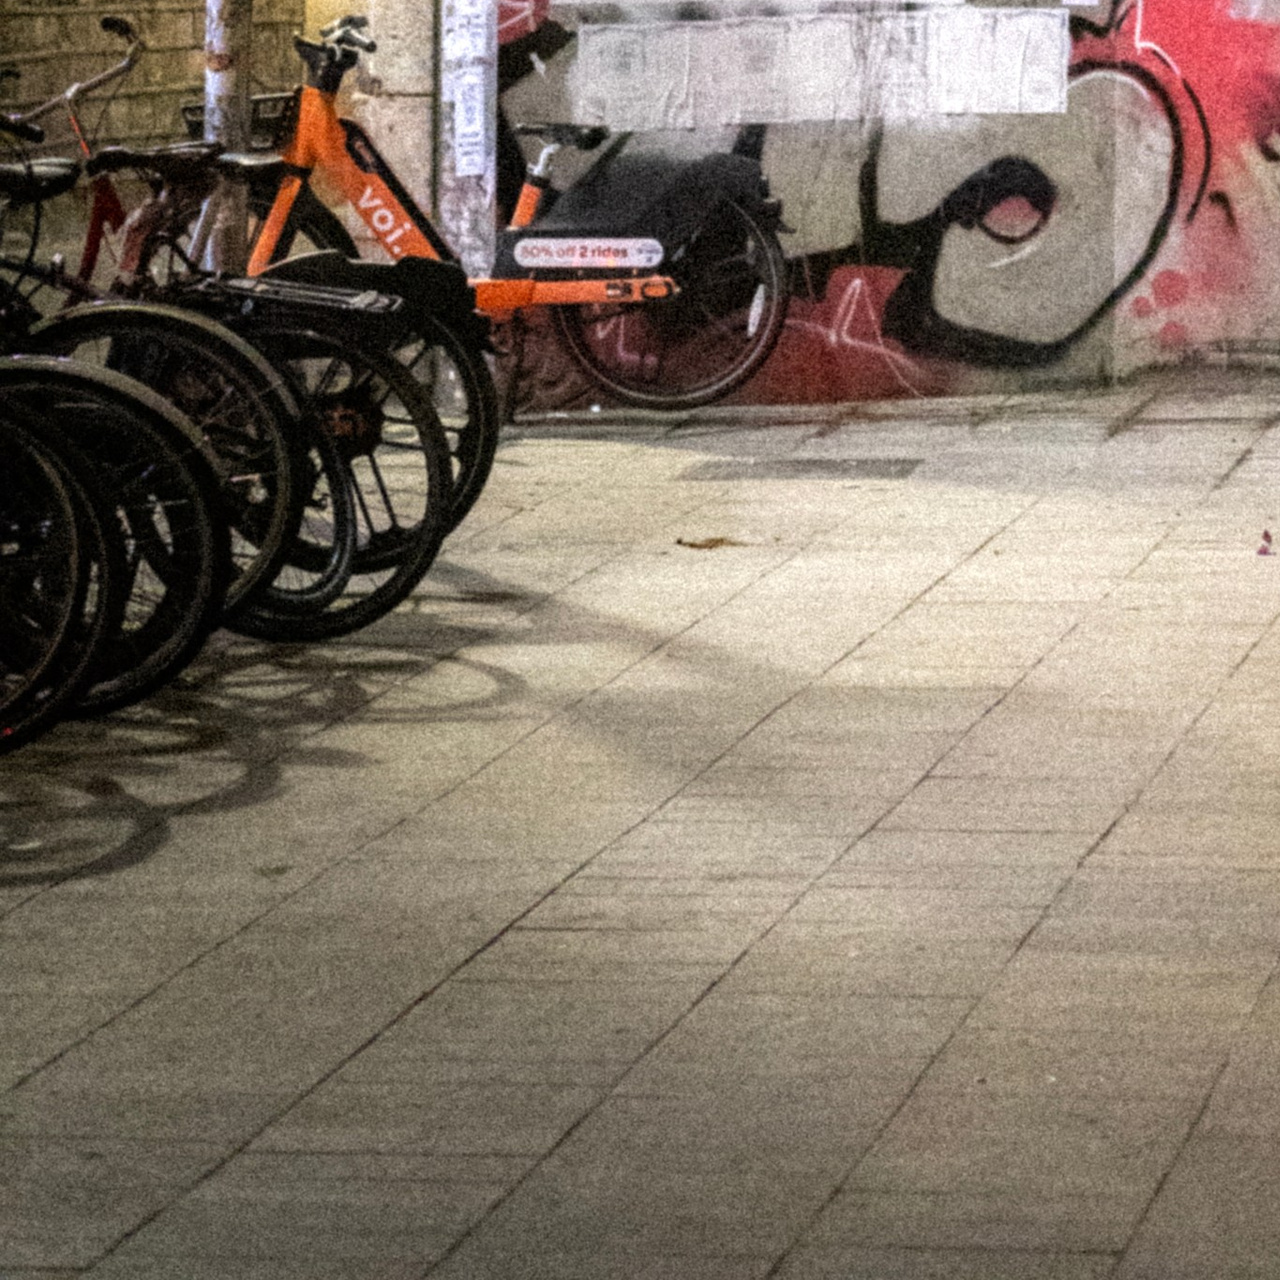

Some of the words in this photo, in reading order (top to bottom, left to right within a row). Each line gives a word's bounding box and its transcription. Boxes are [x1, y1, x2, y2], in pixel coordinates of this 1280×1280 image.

[358, 185, 413, 255] voi.
[579, 244, 589, 259] 2
[591, 244, 628, 259] rides
